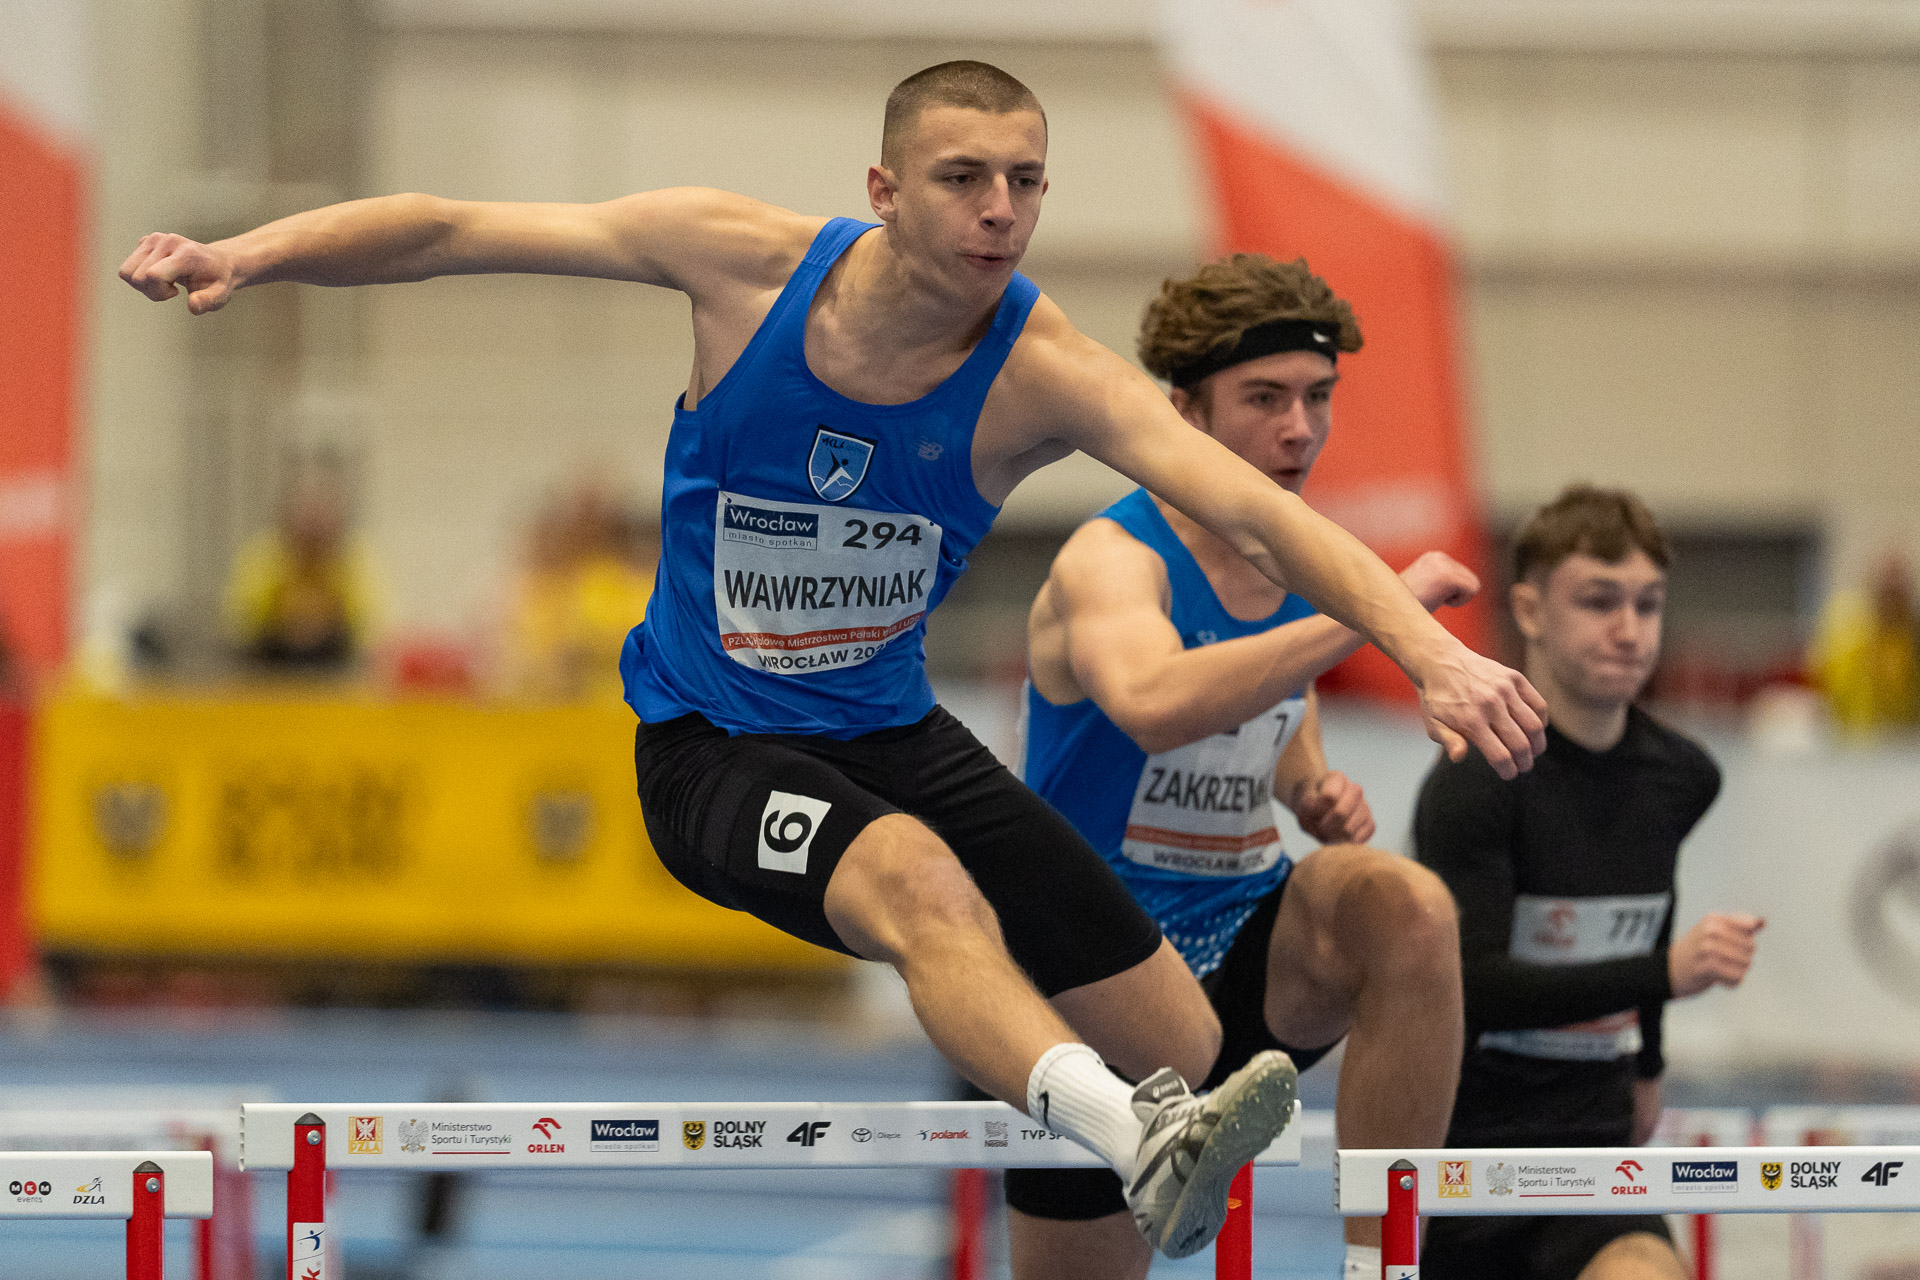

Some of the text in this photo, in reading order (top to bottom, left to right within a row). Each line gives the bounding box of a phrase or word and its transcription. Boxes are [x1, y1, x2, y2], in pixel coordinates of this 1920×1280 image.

[730, 508, 813, 531] Wrocław
[728, 532, 812, 549] miasto spotkań
[843, 519, 922, 550] 294
[724, 569, 926, 612] WAWRZYNIAK
[788, 634, 847, 648] Mistrzostwa
[850, 629, 880, 641] Polski
[758, 649, 849, 669] WROCŁAW
[763, 809, 812, 853] 6
[432, 1122, 492, 1132] Ministerstwo
[594, 1122, 656, 1137] Wrocław
[713, 1121, 767, 1134] DOLNY
[786, 1121, 832, 1147] 4F
[432, 1134, 462, 1145] Sportu
[470, 1134, 512, 1146] Turystyki
[713, 1132, 763, 1149] ŚLĄSK
[929, 1130, 969, 1142] polanik
[1020, 1130, 1045, 1140] TVP
[527, 1144, 565, 1153] ORLEN
[1518, 1166, 1576, 1175] Ministerstwo
[1675, 1163, 1735, 1179] Wrocław
[1791, 1161, 1841, 1174] DOLNY
[1861, 1161, 1904, 1187] 4F
[10, 1182, 51, 1194] MKM
[1518, 1177, 1548, 1188] Sportu
[1555, 1177, 1596, 1188] Turystyki
[1791, 1173, 1838, 1190] ŚLĄSK
[1611, 1186, 1647, 1195] ORLEN
[73, 1195, 105, 1204] DZLA
